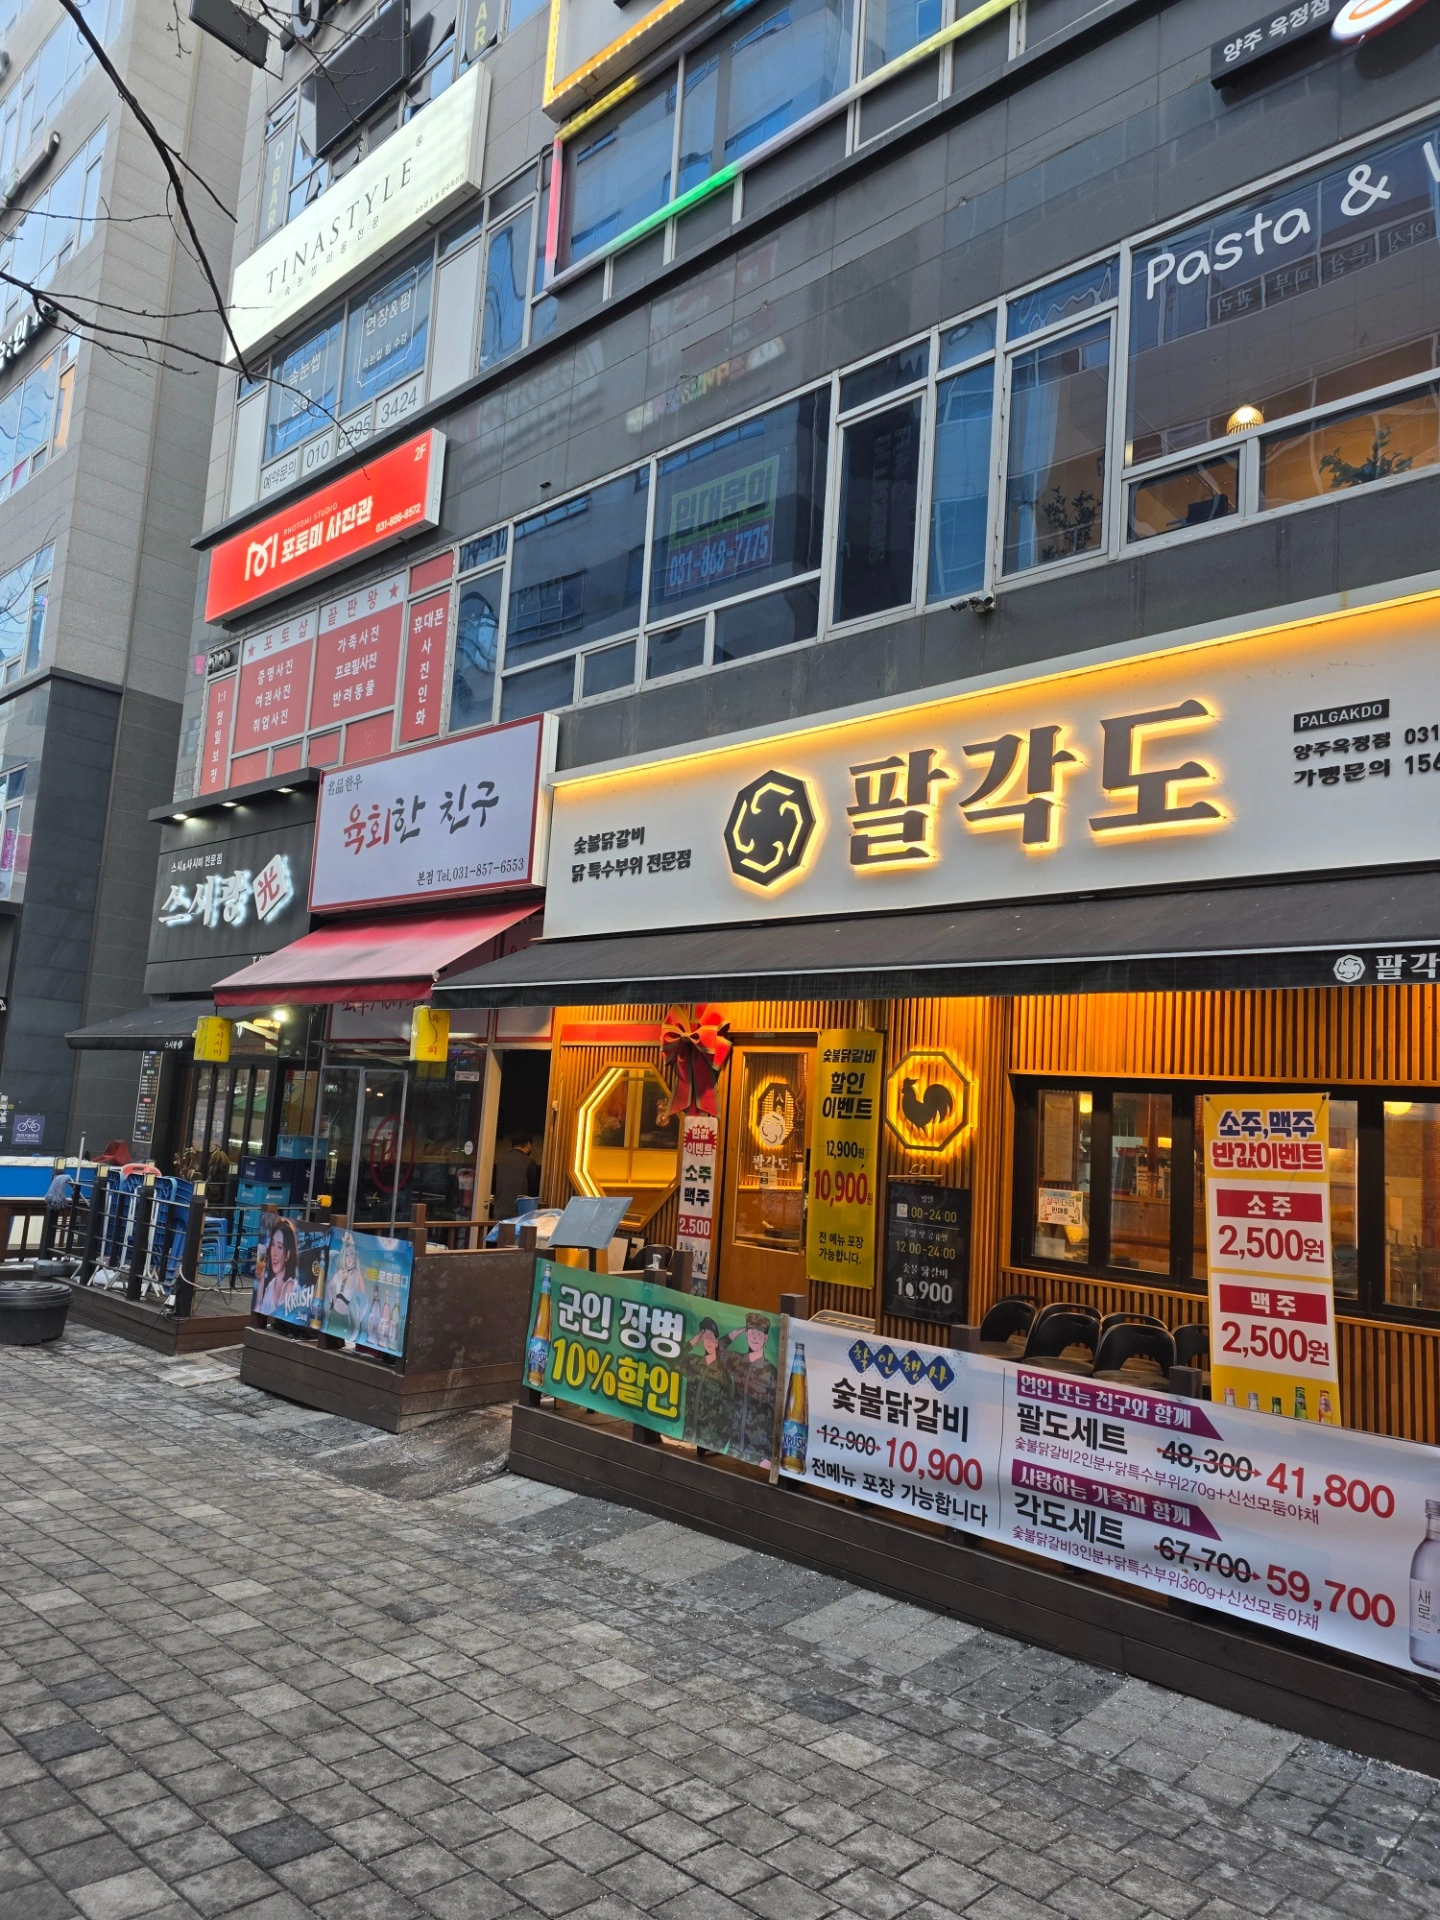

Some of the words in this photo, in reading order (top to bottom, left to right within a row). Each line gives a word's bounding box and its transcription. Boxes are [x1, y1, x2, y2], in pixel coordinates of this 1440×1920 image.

[1224, 28, 1262, 63] 양주
[1269, 0, 1330, 38] 옥정점
[266, 157, 412, 295] TINASTYLE
[1147, 208, 1311, 300] Pasta
[1340, 164, 1391, 216] &
[365, 288, 412, 336] 연장&펌
[289, 351, 322, 387] 속눈썹
[263, 459, 297, 490] 예약문의
[306, 440, 330, 469] 010
[338, 414, 371, 451] 6295
[381, 386, 418, 424] 3424
[414, 443, 427, 462] 2F
[280, 520, 324, 564] 포토미
[325, 495, 373, 543] 사진관
[283, 516, 312, 537] PHOTOMI
[314, 502, 338, 523] STUDIO
[669, 525, 770, 586] 031-868-7775
[413, 608, 445, 634] 휴대폰
[338, 625, 380, 653] 가족사진
[257, 658, 294, 685] 증명사진
[335, 652, 378, 680] 프로필사진
[255, 684, 291, 708] 여권사진
[333, 679, 375, 708] 반려동물
[253, 708, 289, 733] 취업사진
[1300, 704, 1383, 728] PALGAKDO
[1293, 732, 1391, 761] 양주옥정점
[327, 774, 363, 796] 名品한우
[847, 699, 1222, 866] 팔각도
[1294, 758, 1391, 787] 가맹문의
[343, 795, 426, 856] 육회한
[439, 780, 500, 835] 친구
[574, 826, 645, 855] 숯불닭갈비
[204, 852, 223, 867] 전문점
[572, 863, 586, 883] 닭
[588, 856, 643, 880] 특수부위
[647, 849, 692, 873] 전문점
[417, 870, 435, 886] 본점
[823, 1049, 876, 1064] 숯불닭갈비
[831, 1071, 865, 1095] 할인
[822, 1097, 873, 1120] 이벤트
[692, 1127, 709, 1140] 반값
[1218, 1110, 1316, 1139] 소주,맥주
[686, 1142, 713, 1155] 이벤트
[752, 1153, 790, 1172] 팔각도
[826, 1139, 865, 1160] 12,900원
[1211, 1140, 1325, 1172] 반값이벤트
[685, 1165, 712, 1184] 소주
[814, 1169, 873, 1207] 10,900원
[684, 1189, 710, 1207] 맥주
[679, 1217, 711, 1236] 2,500
[818, 1232, 827, 1244] 전
[829, 1233, 845, 1247] 메뉴
[847, 1235, 864, 1249] 포장
[818, 1247, 861, 1266] 가능합니다.
[896, 1240, 956, 1260] 12:00-24:00
[1218, 1224, 1325, 1264] 2,500원
[285, 1285, 315, 1317] KRUSH
[558, 1285, 612, 1340] 군인
[619, 1299, 684, 1359] 장병
[1221, 1320, 1330, 1367] 2,500원
[551, 1338, 680, 1419] 10%할인
[832, 1377, 969, 1443] 숯불닭갈비
[1020, 1375, 1054, 1399] 연인
[1057, 1381, 1092, 1406] 또는
[1096, 1390, 1149, 1419] 친구와
[1154, 1404, 1192, 1430] 함께
[783, 1432, 808, 1451] KRUSH
[1016, 1402, 1128, 1455] 팔도세트
[821, 1424, 876, 1456] 12,900
[886, 1436, 983, 1491] 10,900
[811, 1457, 856, 1488] 전메뉴
[862, 1472, 895, 1500] 포장
[901, 1484, 988, 1527] 가능합니다
[1161, 1439, 1253, 1483] 48,300
[1266, 1461, 1396, 1519] 41,800
[1019, 1466, 1087, 1498] 사랑하는
[1092, 1483, 1148, 1513] 가족과
[1153, 1500, 1191, 1527] 함께
[1014, 1491, 1125, 1550] 각도세트
[1159, 1535, 1252, 1585] 67,700
[1266, 1563, 1397, 1629] 59,700
